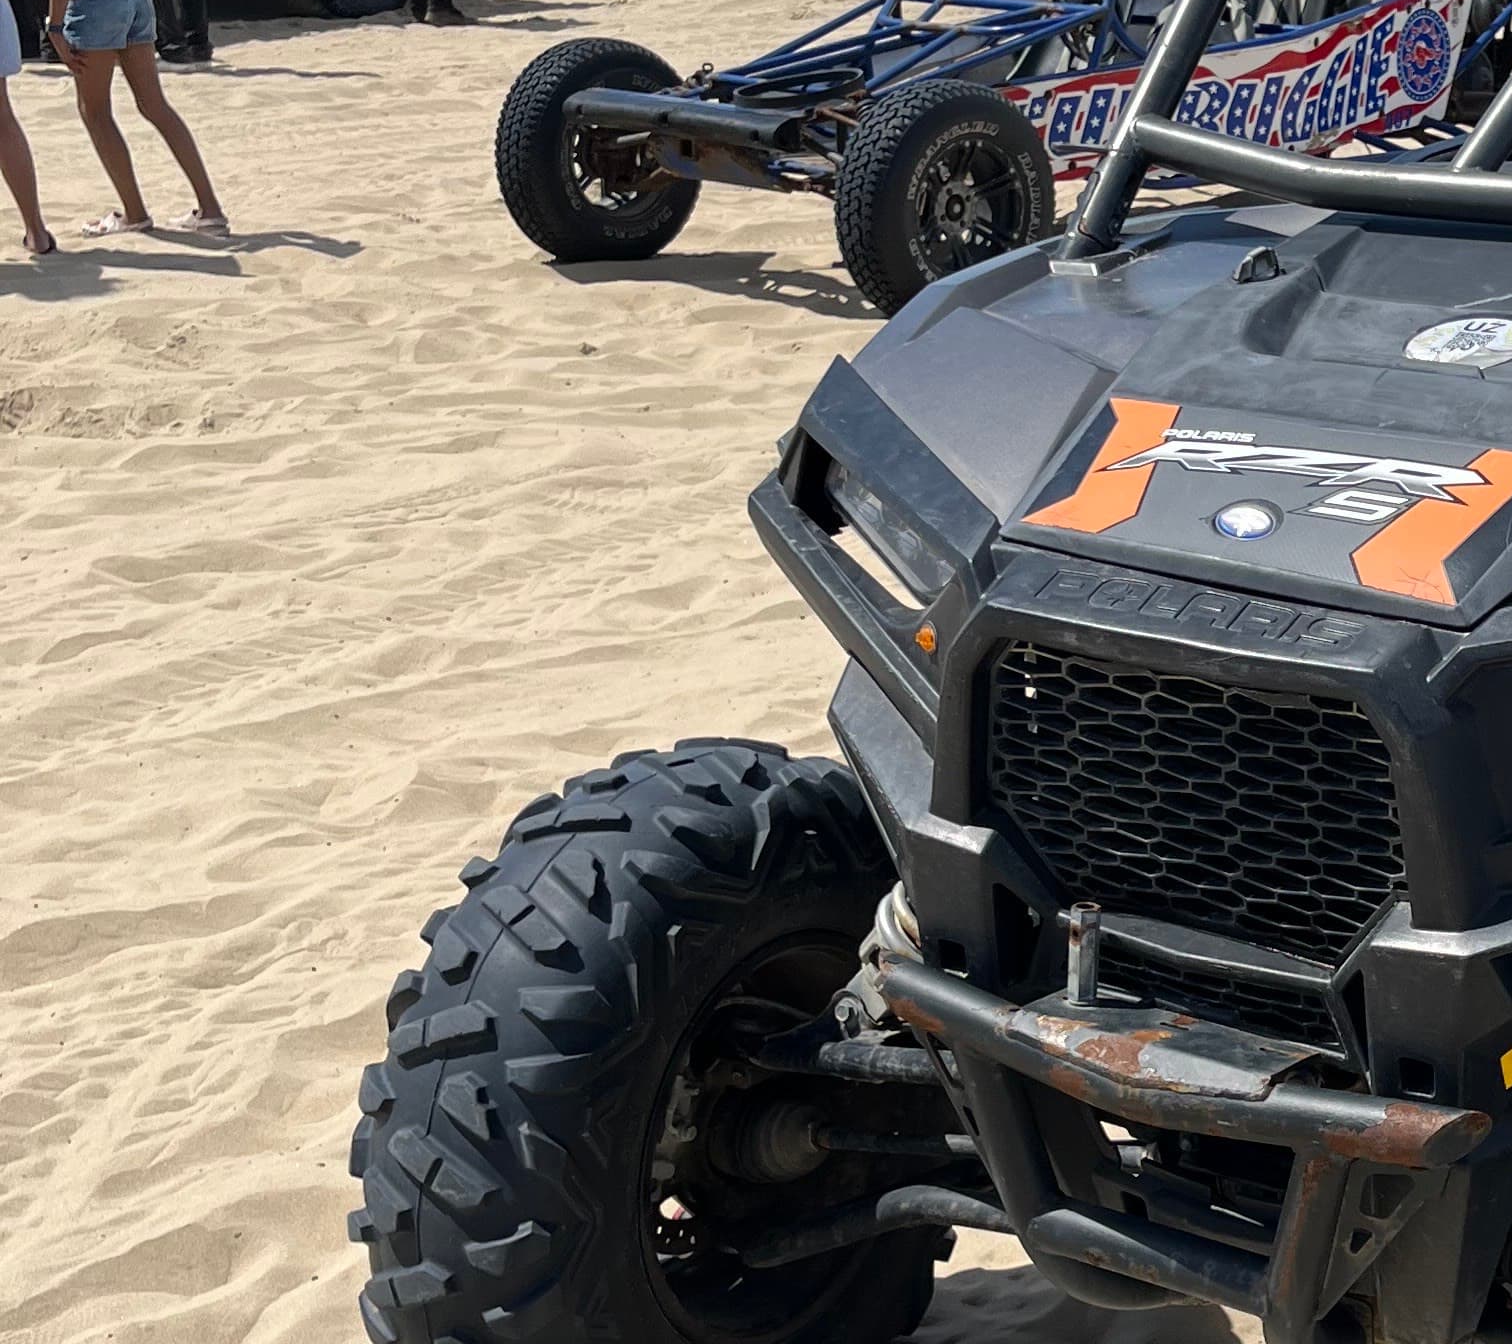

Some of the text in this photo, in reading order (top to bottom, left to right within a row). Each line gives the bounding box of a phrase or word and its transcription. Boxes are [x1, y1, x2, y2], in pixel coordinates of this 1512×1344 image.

[1160, 427, 1257, 444] POLARIS
[1096, 440, 1491, 505] RZR
[1033, 569, 1369, 648] POLARIS
